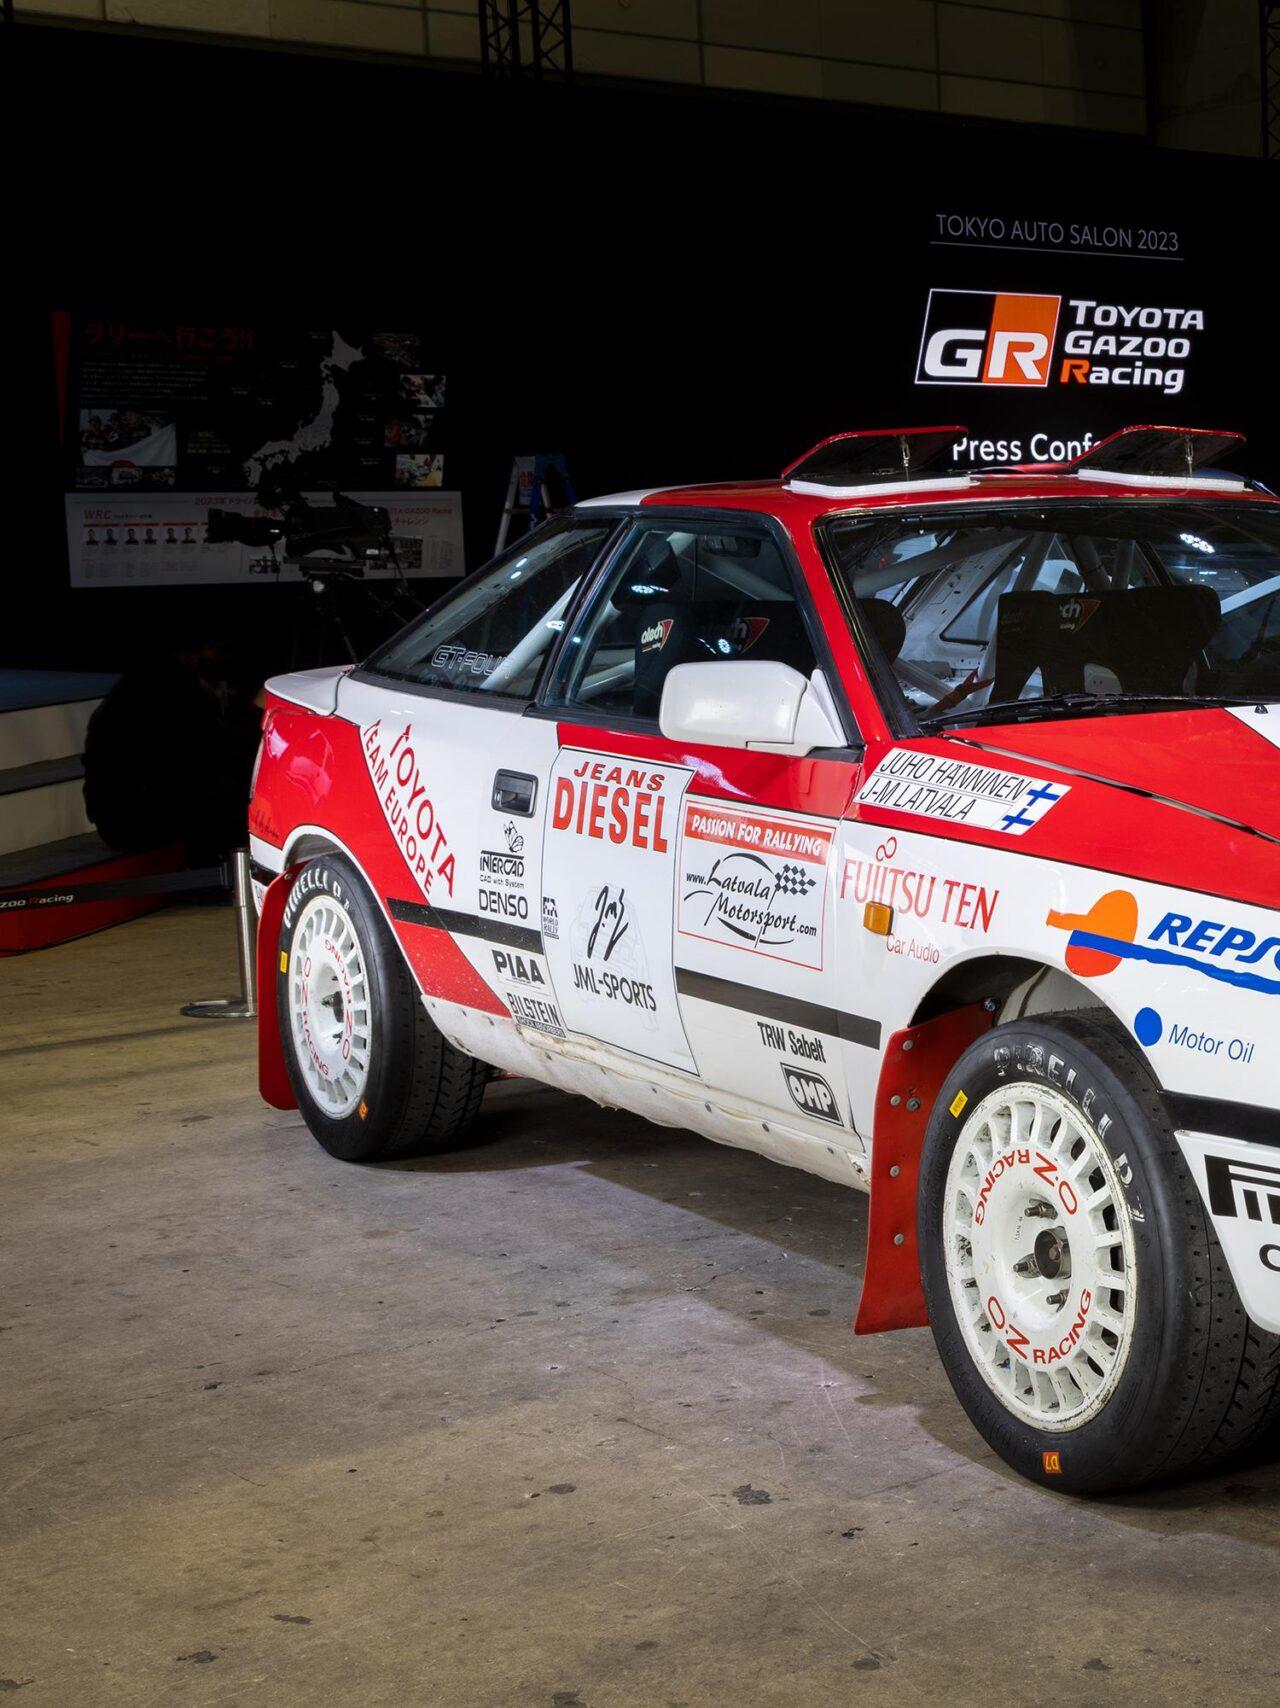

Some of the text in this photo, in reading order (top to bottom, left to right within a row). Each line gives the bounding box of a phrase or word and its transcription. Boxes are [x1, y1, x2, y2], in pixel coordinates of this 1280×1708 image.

[935, 213, 1180, 251] TOKYO AUTO SALON 2023
[1069, 300, 1205, 330] TOYOTA
[924, 328, 1191, 381] GR GAZOO
[1060, 358, 1186, 395] Racing
[952, 432, 1101, 462] Press Conf
[573, 760, 666, 791] JEANS
[880, 750, 1032, 801] JUHO HÄNNINEN
[364, 719, 434, 895] TEAM EUROPE
[389, 723, 456, 898] TOYOTA
[552, 776, 669, 854] DIESEL
[858, 779, 978, 821] J-M LATVALA
[692, 815, 822, 857] PASSION FOR RALLYING
[479, 874, 492, 884] CAD
[480, 850, 525, 878] INTERCAD
[283, 868, 329, 930] PIRELLI
[478, 888, 529, 920] DENSO
[939, 878, 1000, 934] TEN
[491, 949, 546, 984] PIAA
[886, 932, 940, 965] Car Audio
[572, 962, 657, 1013] JML-SPORTS
[506, 992, 562, 1027] BILSTEIN
[757, 1021, 828, 1064] TRW Sabelt
[1168, 1023, 1256, 1064] Motor Oil
[787, 1075, 833, 1114] OMP
[993, 1042, 1113, 1140] PIRELLI
[975, 1148, 1032, 1226] RACING
[1033, 1286, 1093, 1365] RACING
